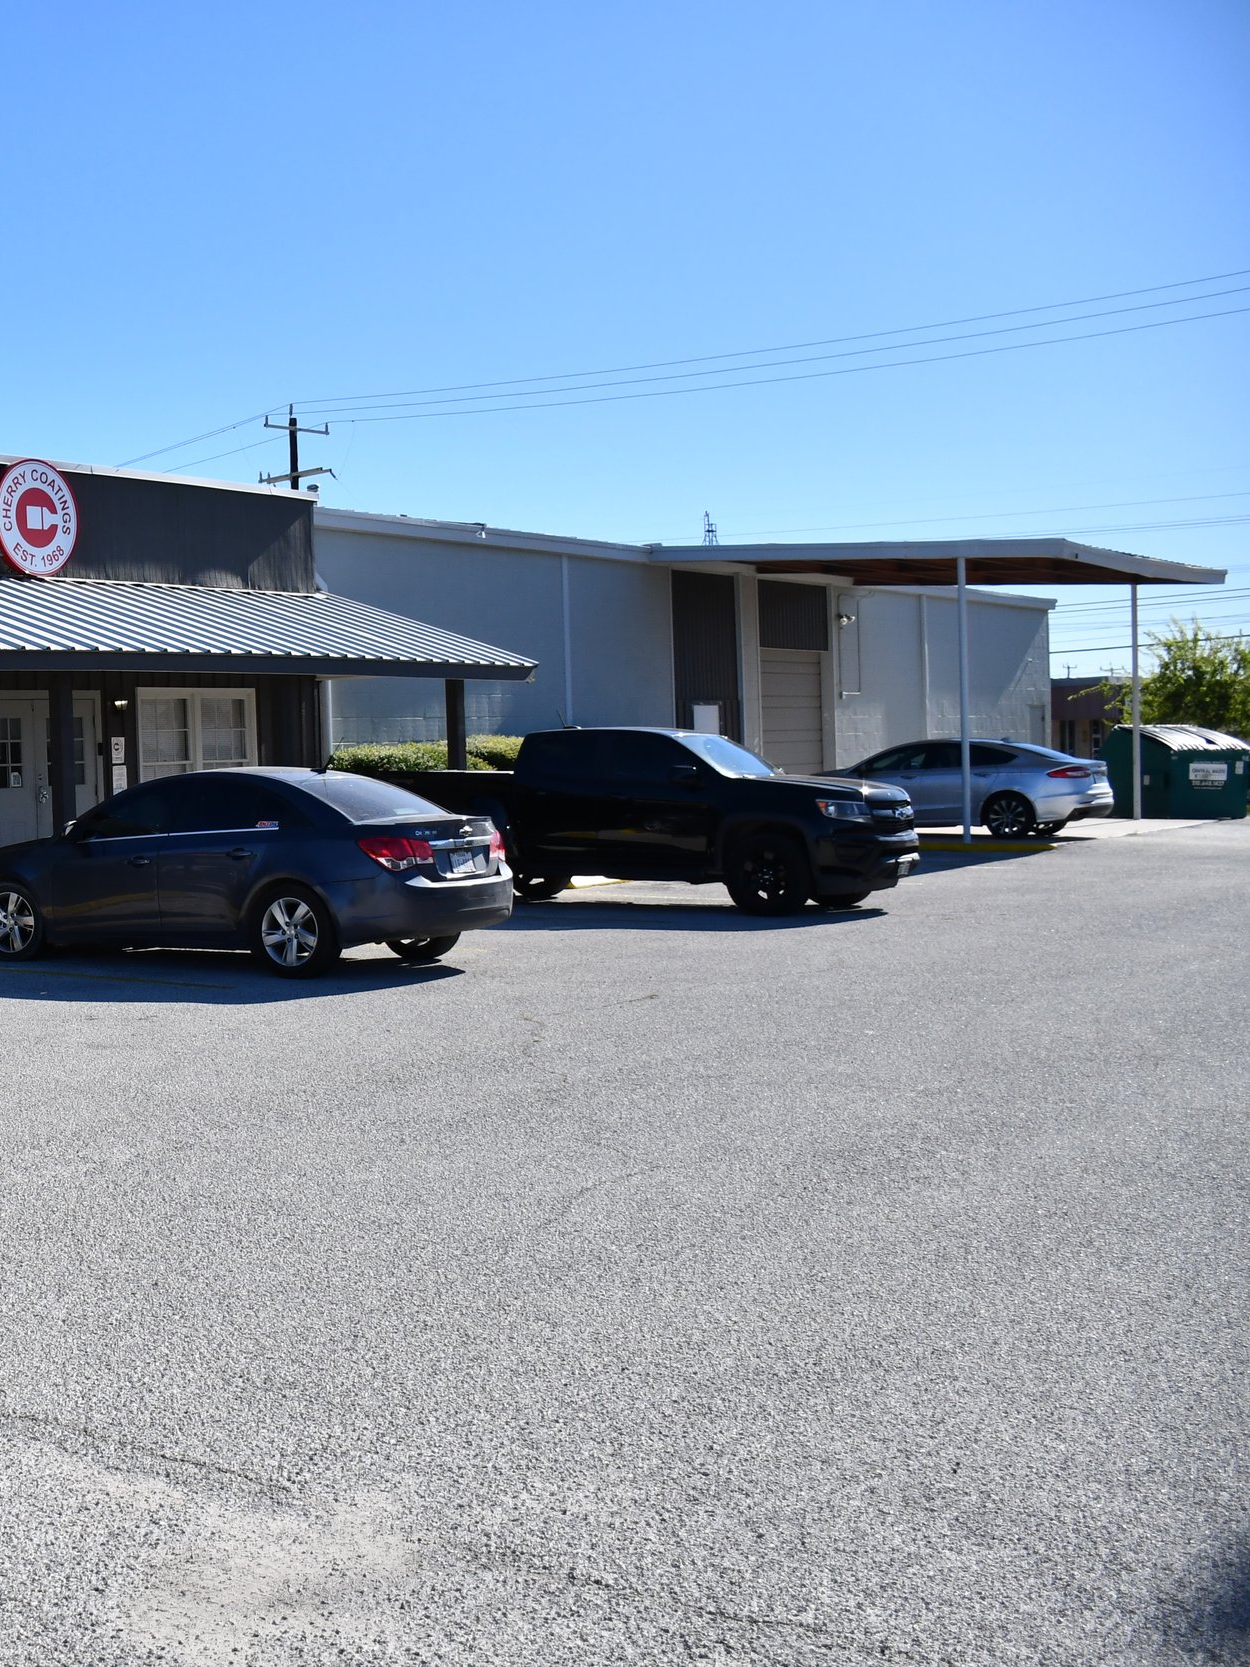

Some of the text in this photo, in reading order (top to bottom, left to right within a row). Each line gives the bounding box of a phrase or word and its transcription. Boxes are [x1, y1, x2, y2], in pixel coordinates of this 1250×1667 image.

[2, 469, 71, 535] CHERRY COATINGS
[13, 542, 65, 567] EST. 1968
